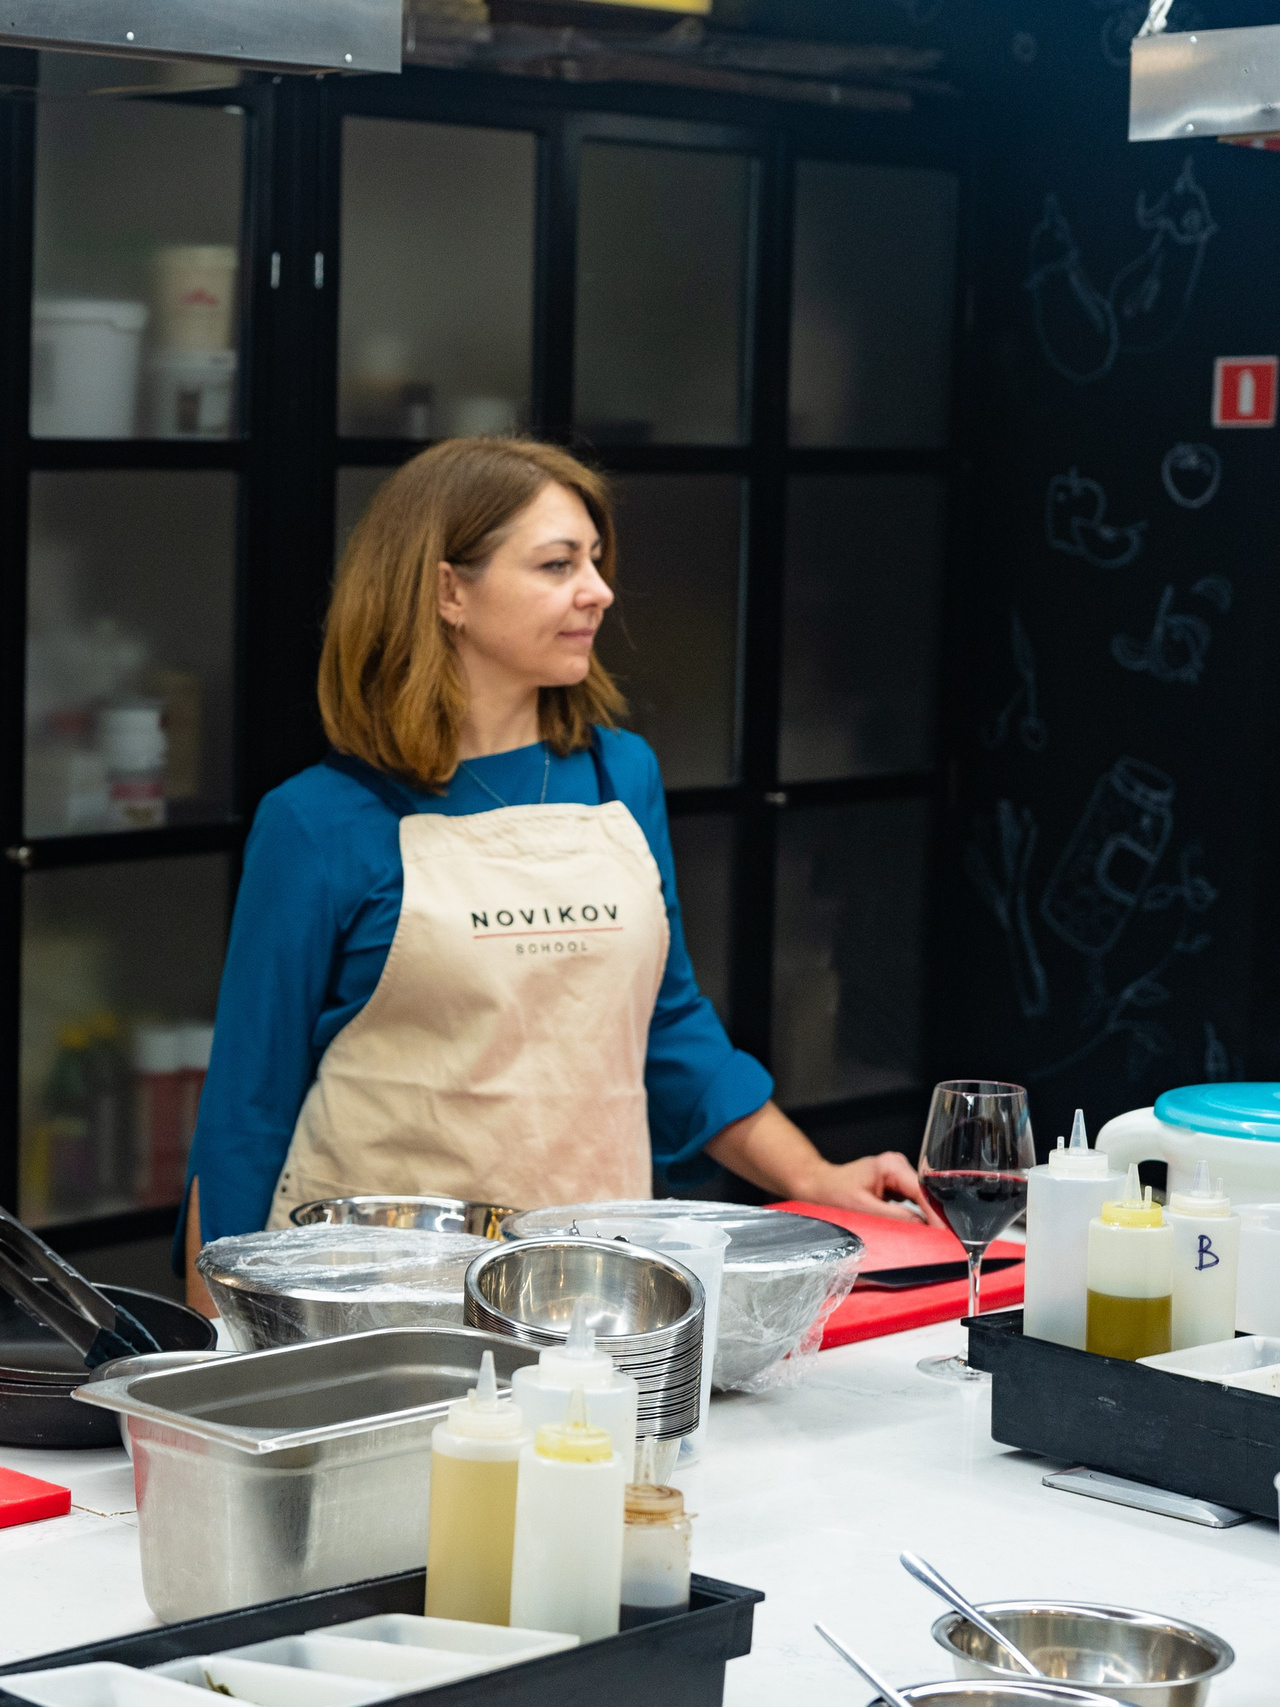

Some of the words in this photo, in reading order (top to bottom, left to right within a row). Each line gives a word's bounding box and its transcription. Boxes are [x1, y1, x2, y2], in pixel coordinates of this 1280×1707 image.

[471, 904, 618, 928] NOVIKOV
[515, 941, 588, 955] SCHOOL
[1195, 1234, 1220, 1271] B
